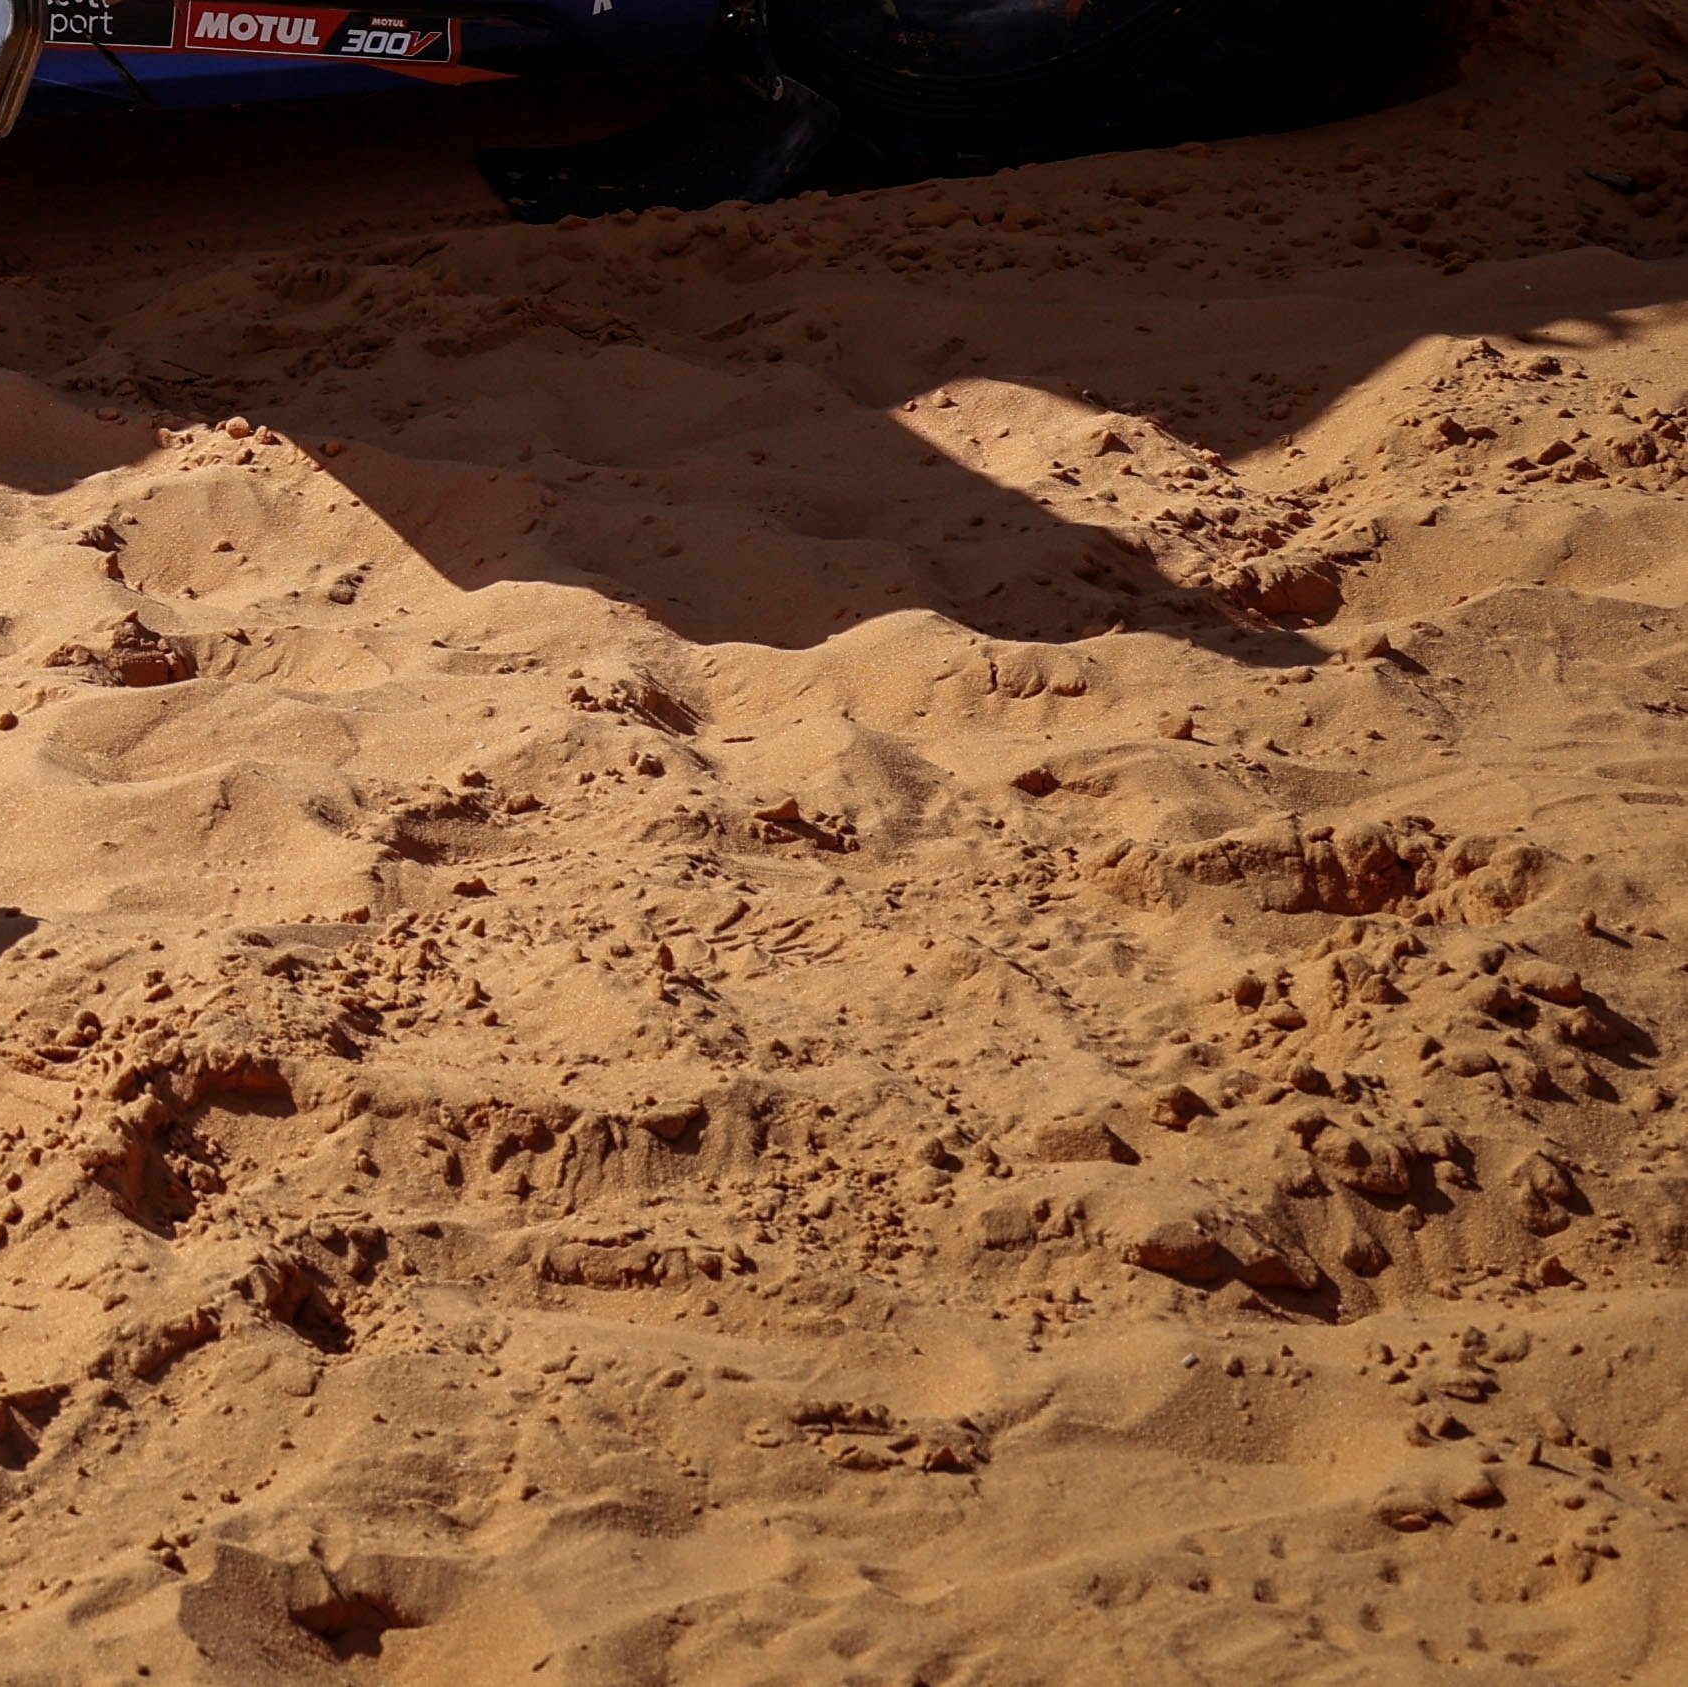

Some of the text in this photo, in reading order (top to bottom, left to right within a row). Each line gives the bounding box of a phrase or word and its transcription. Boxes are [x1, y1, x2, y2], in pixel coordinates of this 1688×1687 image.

[195, 12, 321, 45] MOTUL
[371, 16, 405, 28] MOTUL
[341, 29, 443, 56] 300V
